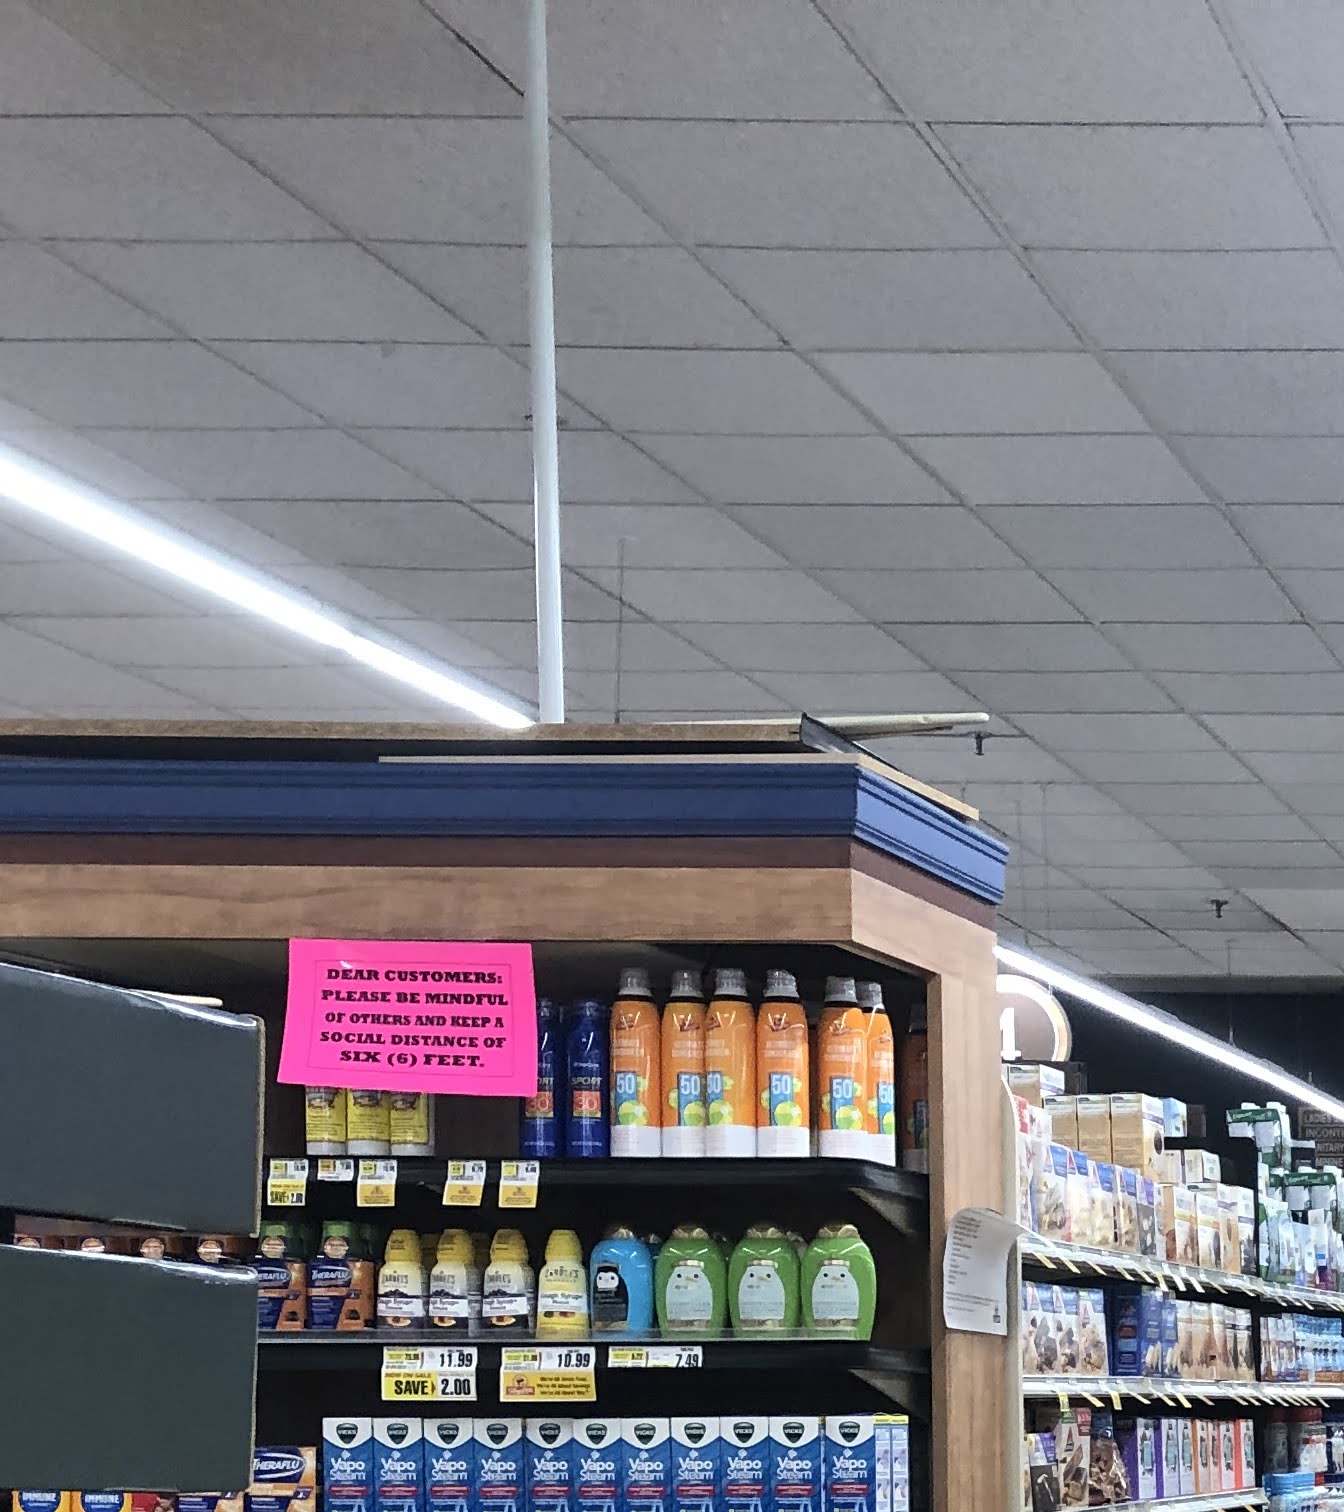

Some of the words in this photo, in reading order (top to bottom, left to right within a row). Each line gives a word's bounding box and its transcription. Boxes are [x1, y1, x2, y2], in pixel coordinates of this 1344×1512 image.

[327, 968, 379, 981] DEAR
[385, 970, 503, 984] CUSTOMERS:
[321, 989, 391, 1003] PLEASE
[396, 991, 420, 1004] BE
[425, 993, 509, 1006] MINDFUL
[325, 1012, 346, 1023] OF
[349, 1013, 411, 1026] OTHERS
[415, 1015, 447, 1027] AND
[450, 1016, 491, 1028] KEEP
[494, 1017, 505, 1028] A
[320, 1031, 386, 1045] SOCIAL
[391, 1034, 479, 1048] DISTANCE
[483, 1037, 507, 1048] OF
[339, 1050, 381, 1063] SIX
[387, 1053, 417, 1067] (6)
[423, 1054, 485, 1068] FEET.
[571, 1076, 602, 1086] SPORT
[616, 1073, 637, 1095] 50
[679, 1073, 700, 1094] 50
[771, 1073, 791, 1095] 50
[832, 1078, 853, 1099] 50
[576, 1096, 598, 1111] 30
[270, 1191, 287, 1203] SAVE
[312, 1269, 349, 1281] THERAFLU
[440, 1353, 473, 1367] 11.99
[558, 1353, 590, 1367] 10.99
[675, 1353, 699, 1367] 7.49
[394, 1380, 428, 1395] SAVE
[441, 1378, 470, 1395] 2.00
[253, 1458, 299, 1471] THERAFLU
[331, 1458, 365, 1471] Vapo
[431, 1458, 467, 1471] Vapo
[580, 1458, 615, 1471] Vapo
[628, 1458, 664, 1471] Vapo
[776, 1457, 812, 1470] Vapo
[833, 1456, 867, 1469] Vapo
[330, 1470, 366, 1481] Steam
[431, 1470, 467, 1481] Steam
[580, 1470, 615, 1481] Steam
[628, 1470, 664, 1481] Steam
[776, 1469, 812, 1480] Steam
[832, 1468, 867, 1479] Steam
